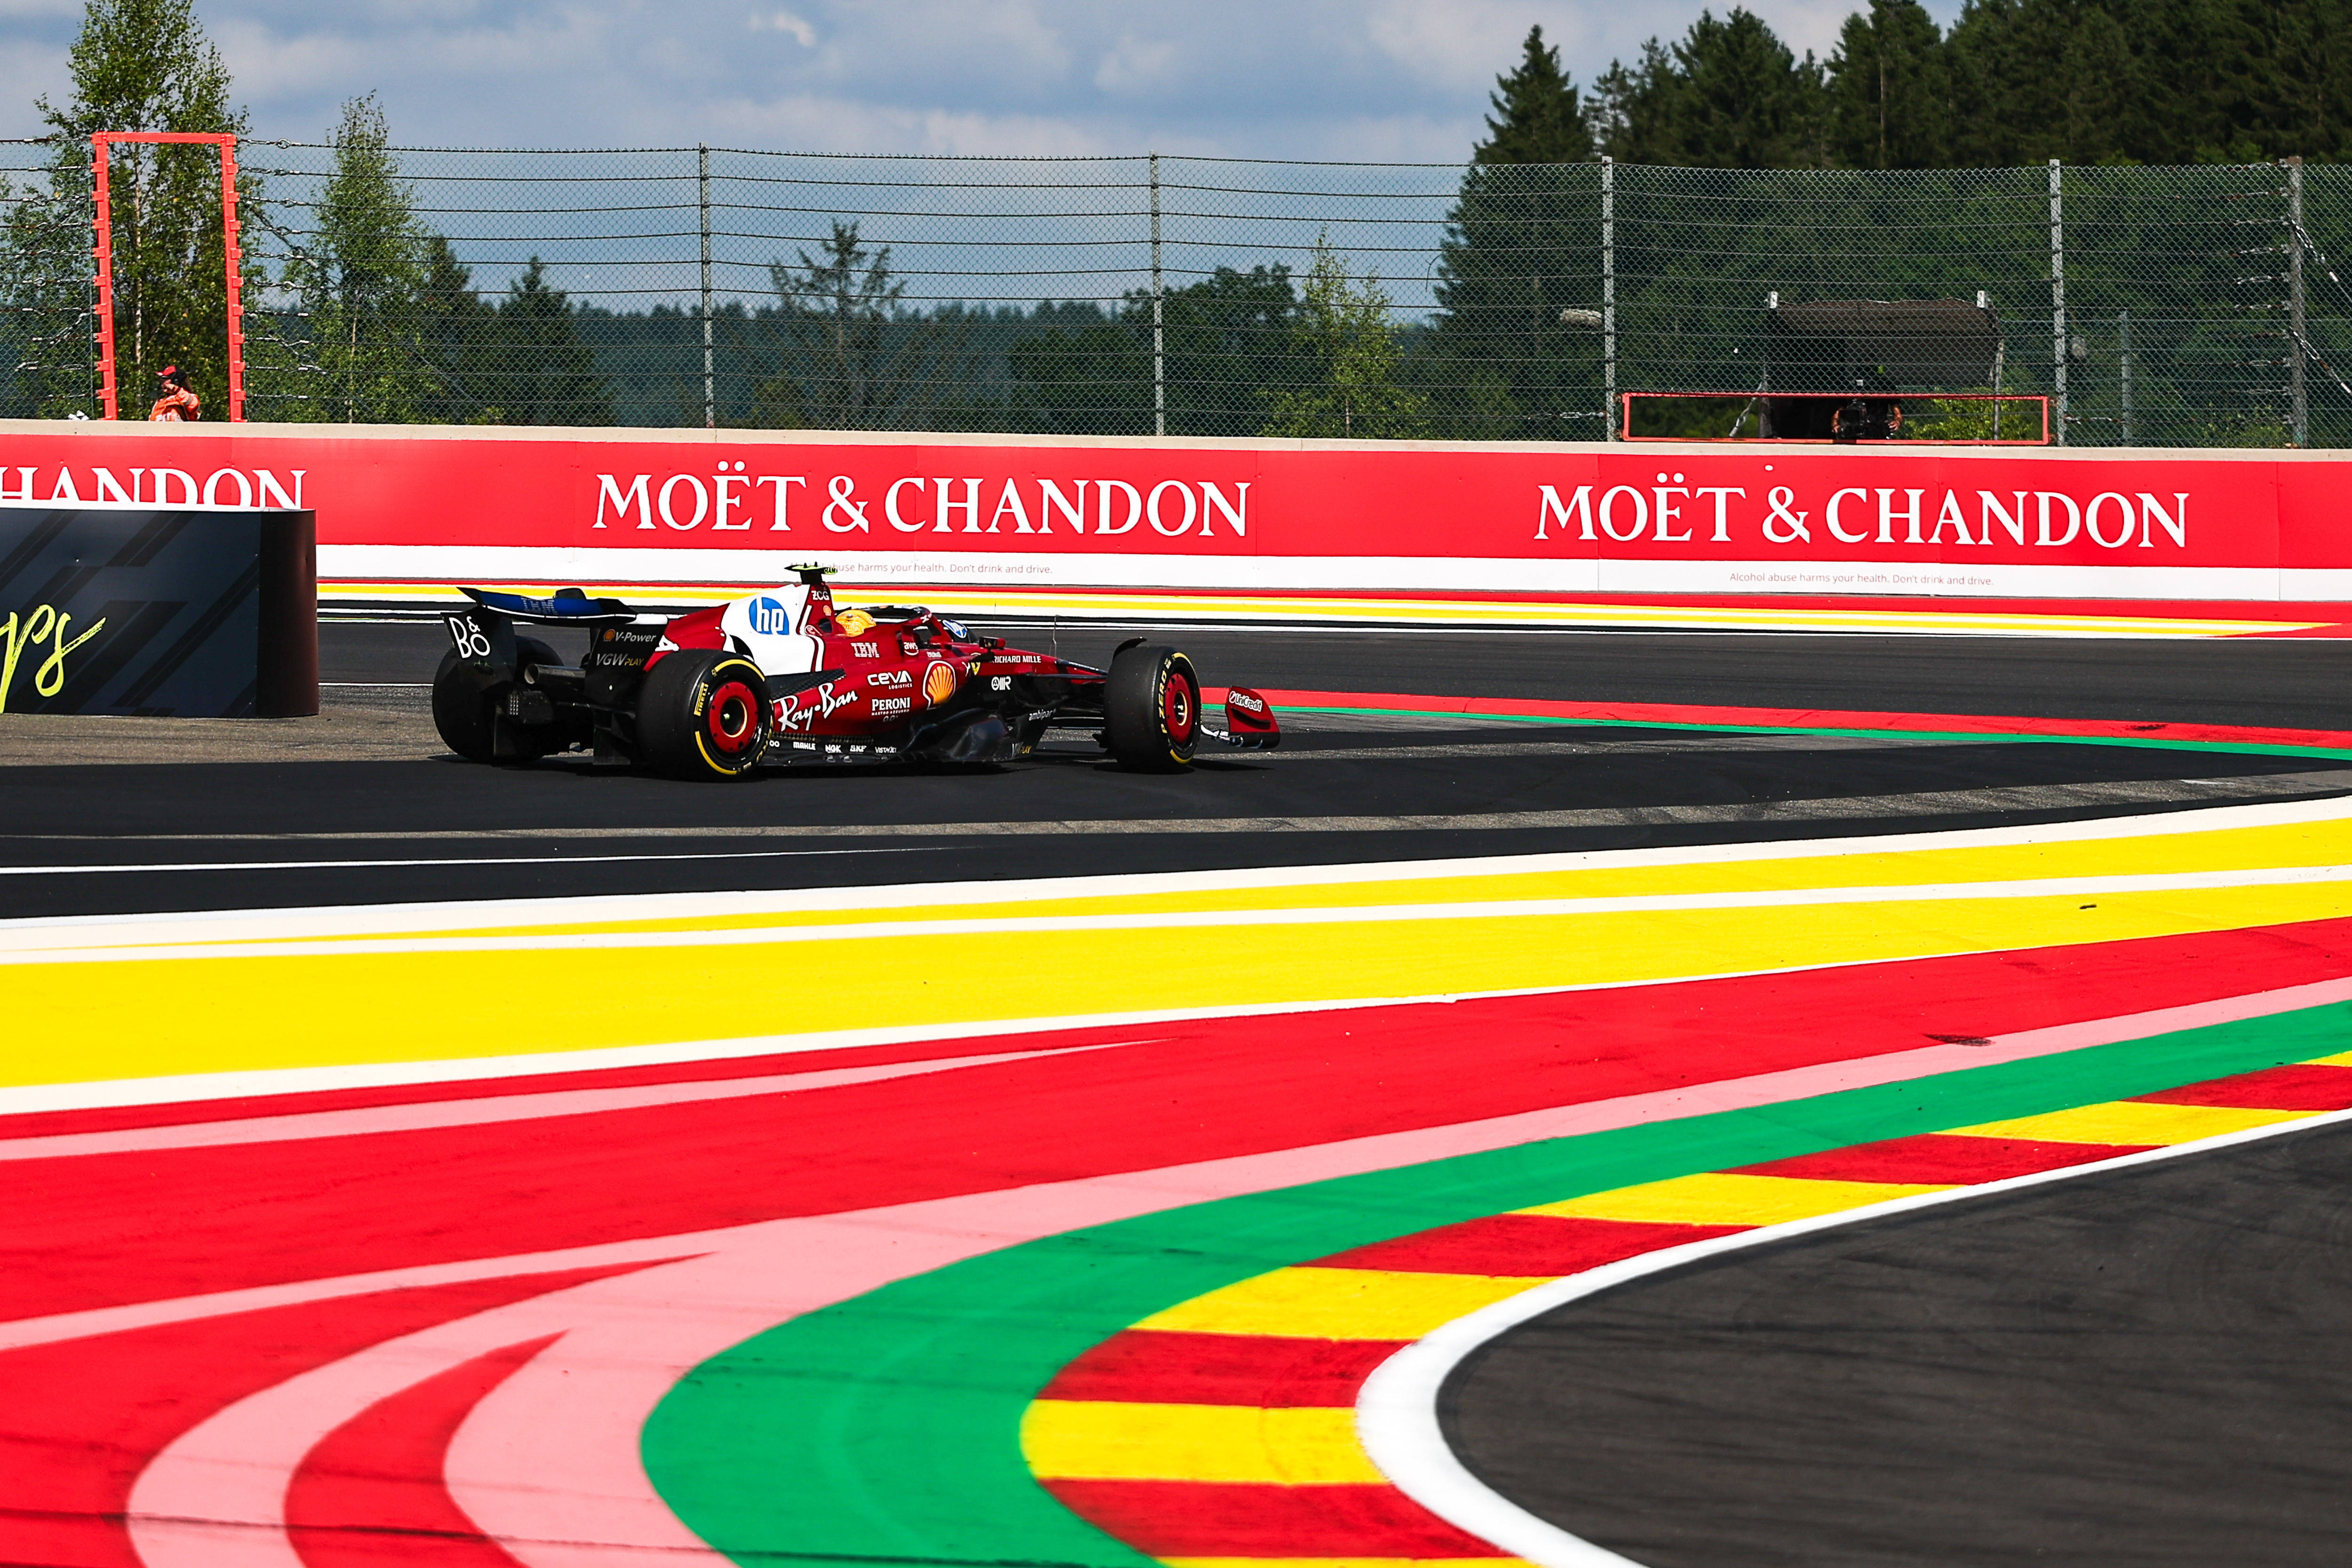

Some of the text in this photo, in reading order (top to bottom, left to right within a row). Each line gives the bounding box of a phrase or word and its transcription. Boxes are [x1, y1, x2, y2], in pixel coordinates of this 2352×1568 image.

[592, 461, 1251, 536] MOËT & CHANDON
[1534, 472, 2189, 548] MOËT & CHANDON
[858, 563, 888, 572] harms
[890, 565, 911, 574] your
[914, 563, 947, 572] health.
[977, 564, 1002, 573] drink
[1005, 565, 1023, 573] and
[1026, 565, 1053, 573] drive.
[1730, 573, 1765, 581] Alcohol
[1768, 573, 1797, 581] abuse
[1800, 573, 1830, 582] harms
[1832, 575, 1854, 584] your
[1857, 573, 1890, 583] health.
[1920, 575, 1944, 584] drink
[1947, 576, 1964, 585] and
[1967, 576, 1994, 585] drive.
[754, 597, 786, 635] hp
[614, 631, 656, 642] V-Power
[850, 643, 880, 658] IBM
[872, 697, 910, 711] PERONI
[793, 741, 816, 750] MAHLE
[825, 744, 842, 753] NGK
